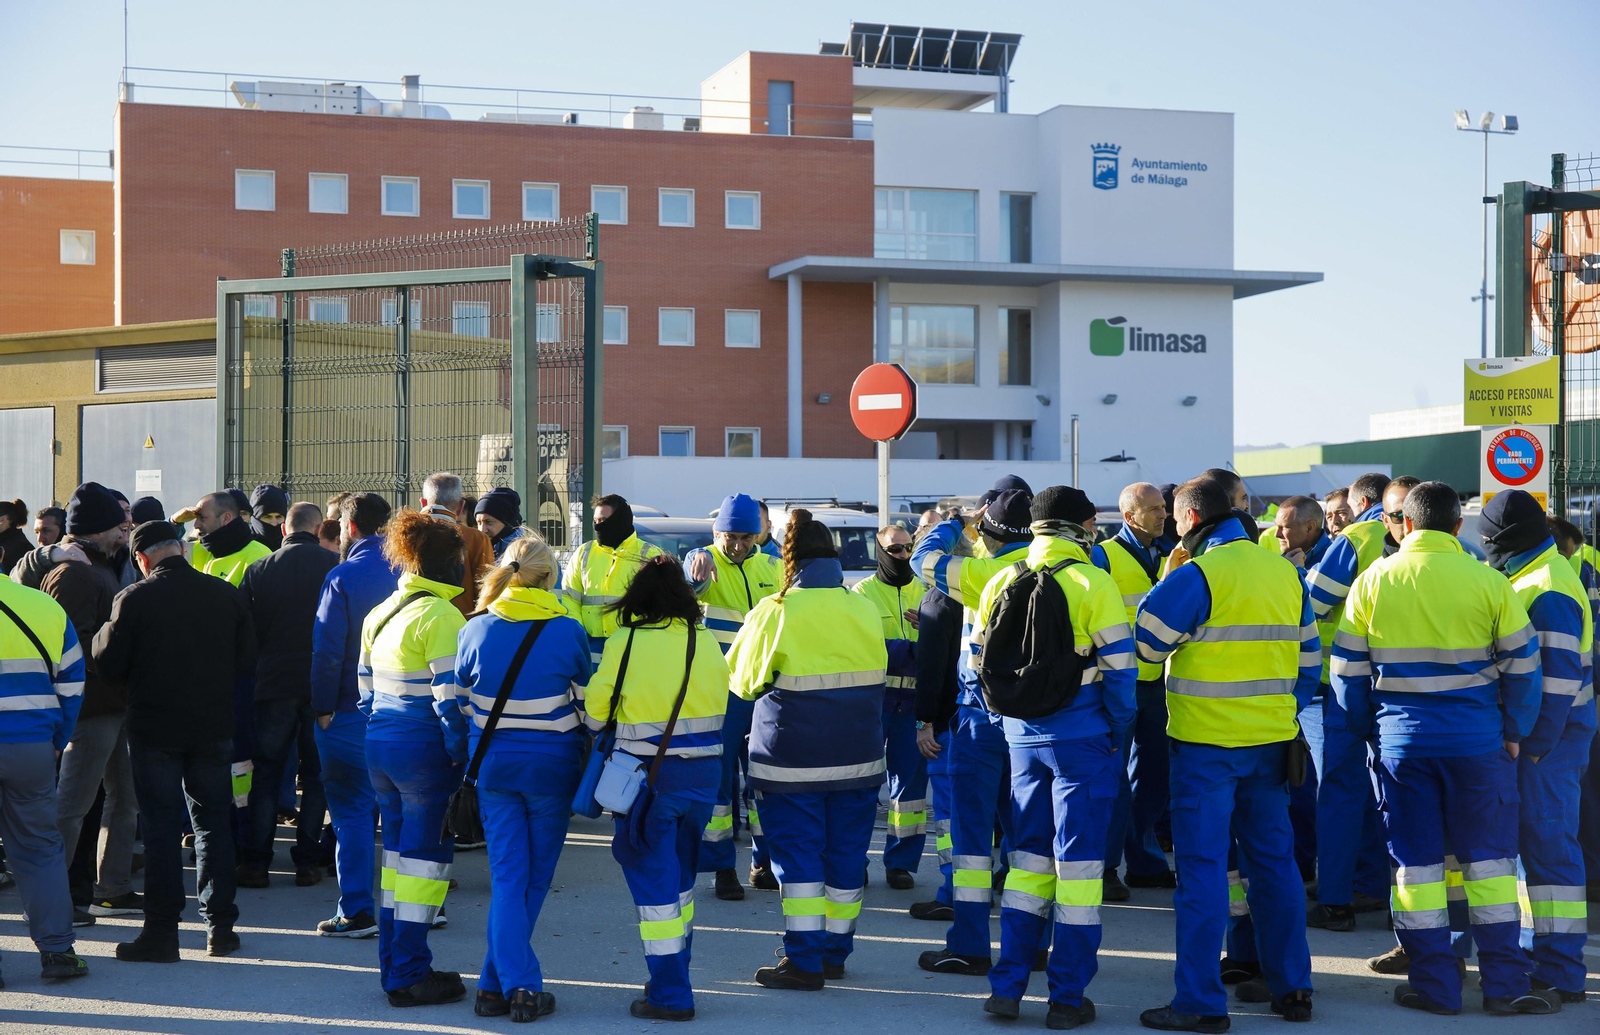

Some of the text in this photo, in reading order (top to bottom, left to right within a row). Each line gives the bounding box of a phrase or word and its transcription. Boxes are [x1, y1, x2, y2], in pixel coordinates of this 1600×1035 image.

[1131, 157, 1208, 172] Ayuntamiento
[1131, 173, 1188, 188] de Málaga
[1129, 326, 1207, 354] limasa
[1469, 387, 1554, 401] ACCESO PERSONAL
[1490, 405, 1533, 417] Y VISITAS
[1488, 432, 1507, 452] ENTRADA
[1496, 457, 1534, 465] PERMANENTE
[1507, 450, 1523, 458] VADO
